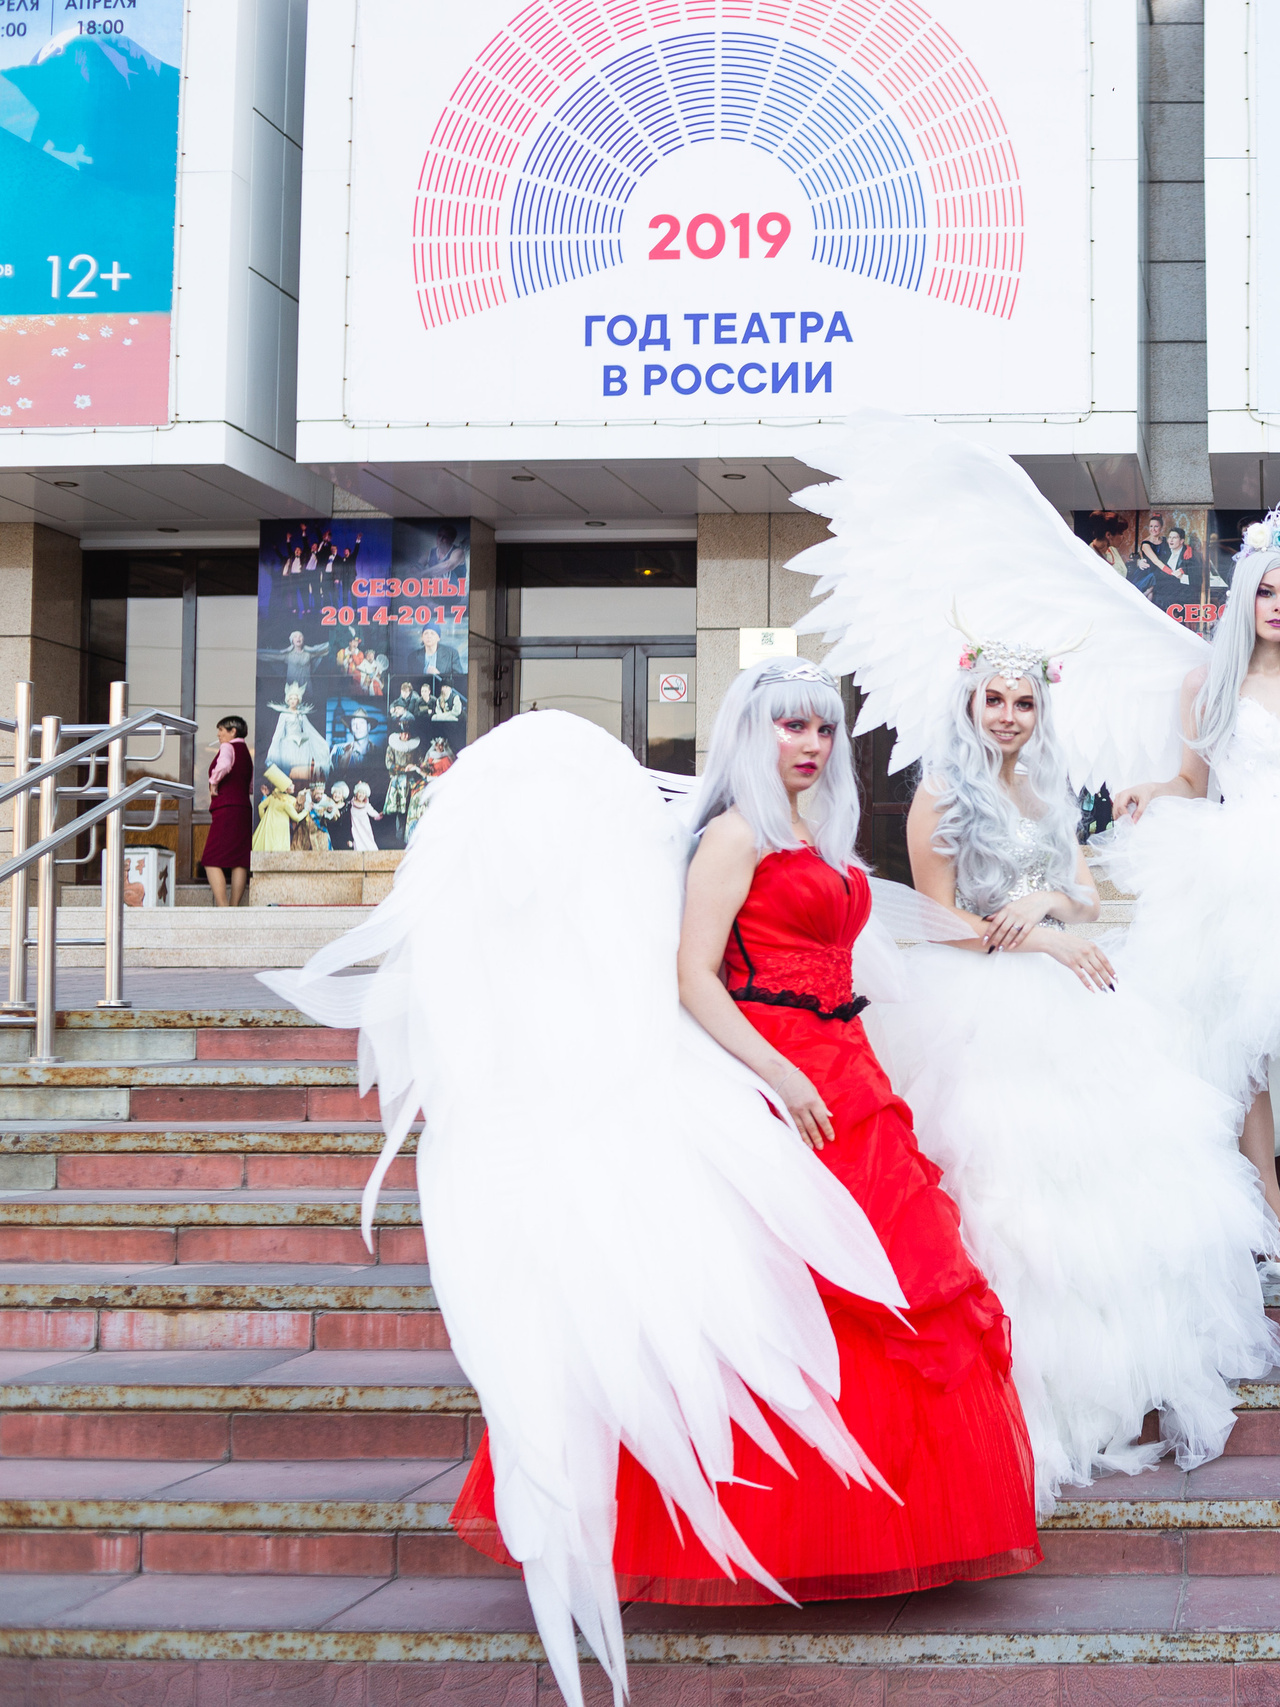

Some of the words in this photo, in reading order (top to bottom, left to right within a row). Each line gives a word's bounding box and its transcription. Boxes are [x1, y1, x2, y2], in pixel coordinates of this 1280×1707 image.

[64, 0, 137, 10] АПРЕЛЯ
[77, 19, 124, 35] 18:00
[647, 211, 792, 261] 2019
[46, 253, 132, 299] 12+
[584, 313, 671, 352] ГОД
[683, 310, 854, 345] ТЕАТРА
[603, 364, 628, 396] В
[643, 360, 833, 396] РОССИИ
[351, 577, 467, 598] СЕЗОНЫ
[320, 605, 467, 626] 2014-2017
